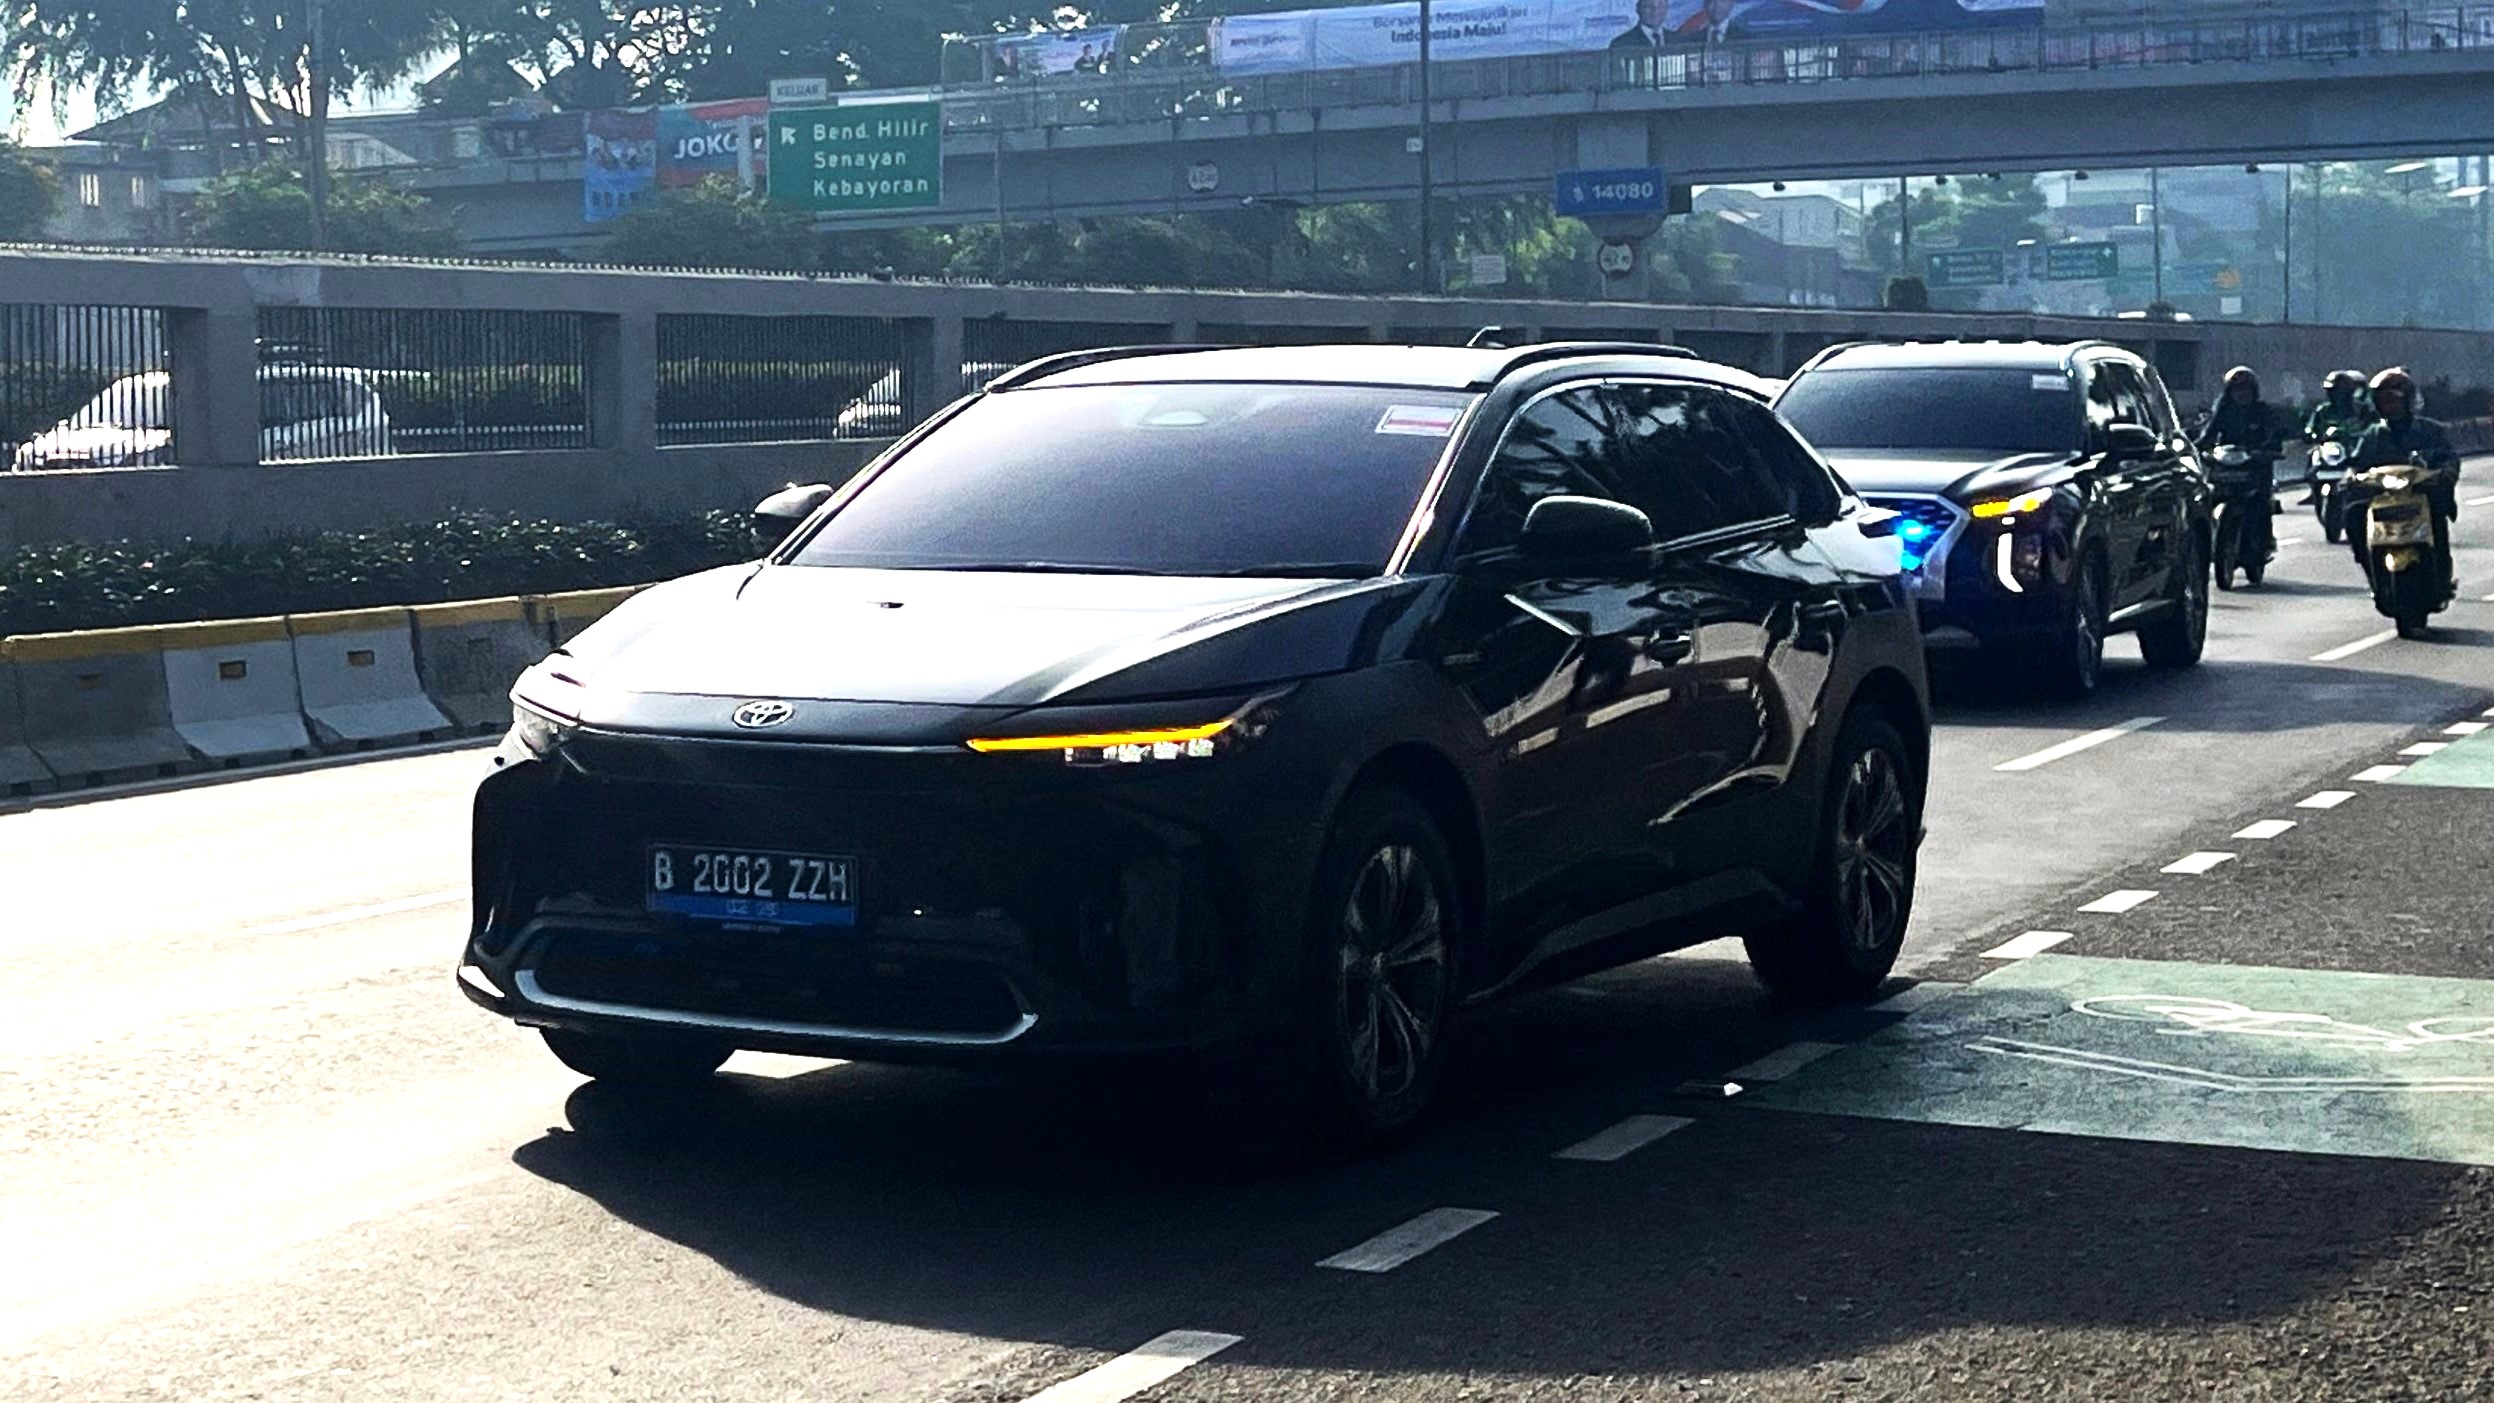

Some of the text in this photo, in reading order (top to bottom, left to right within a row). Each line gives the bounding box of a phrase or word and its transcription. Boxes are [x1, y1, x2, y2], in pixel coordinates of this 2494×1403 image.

[1391, 22, 1506, 43] Indoesia Maju!
[877, 118, 929, 138] Hilir
[814, 151, 906, 170] Senayan
[813, 177, 928, 199] Kebayoran
[655, 852, 847, 900] B 2002 ZZH
